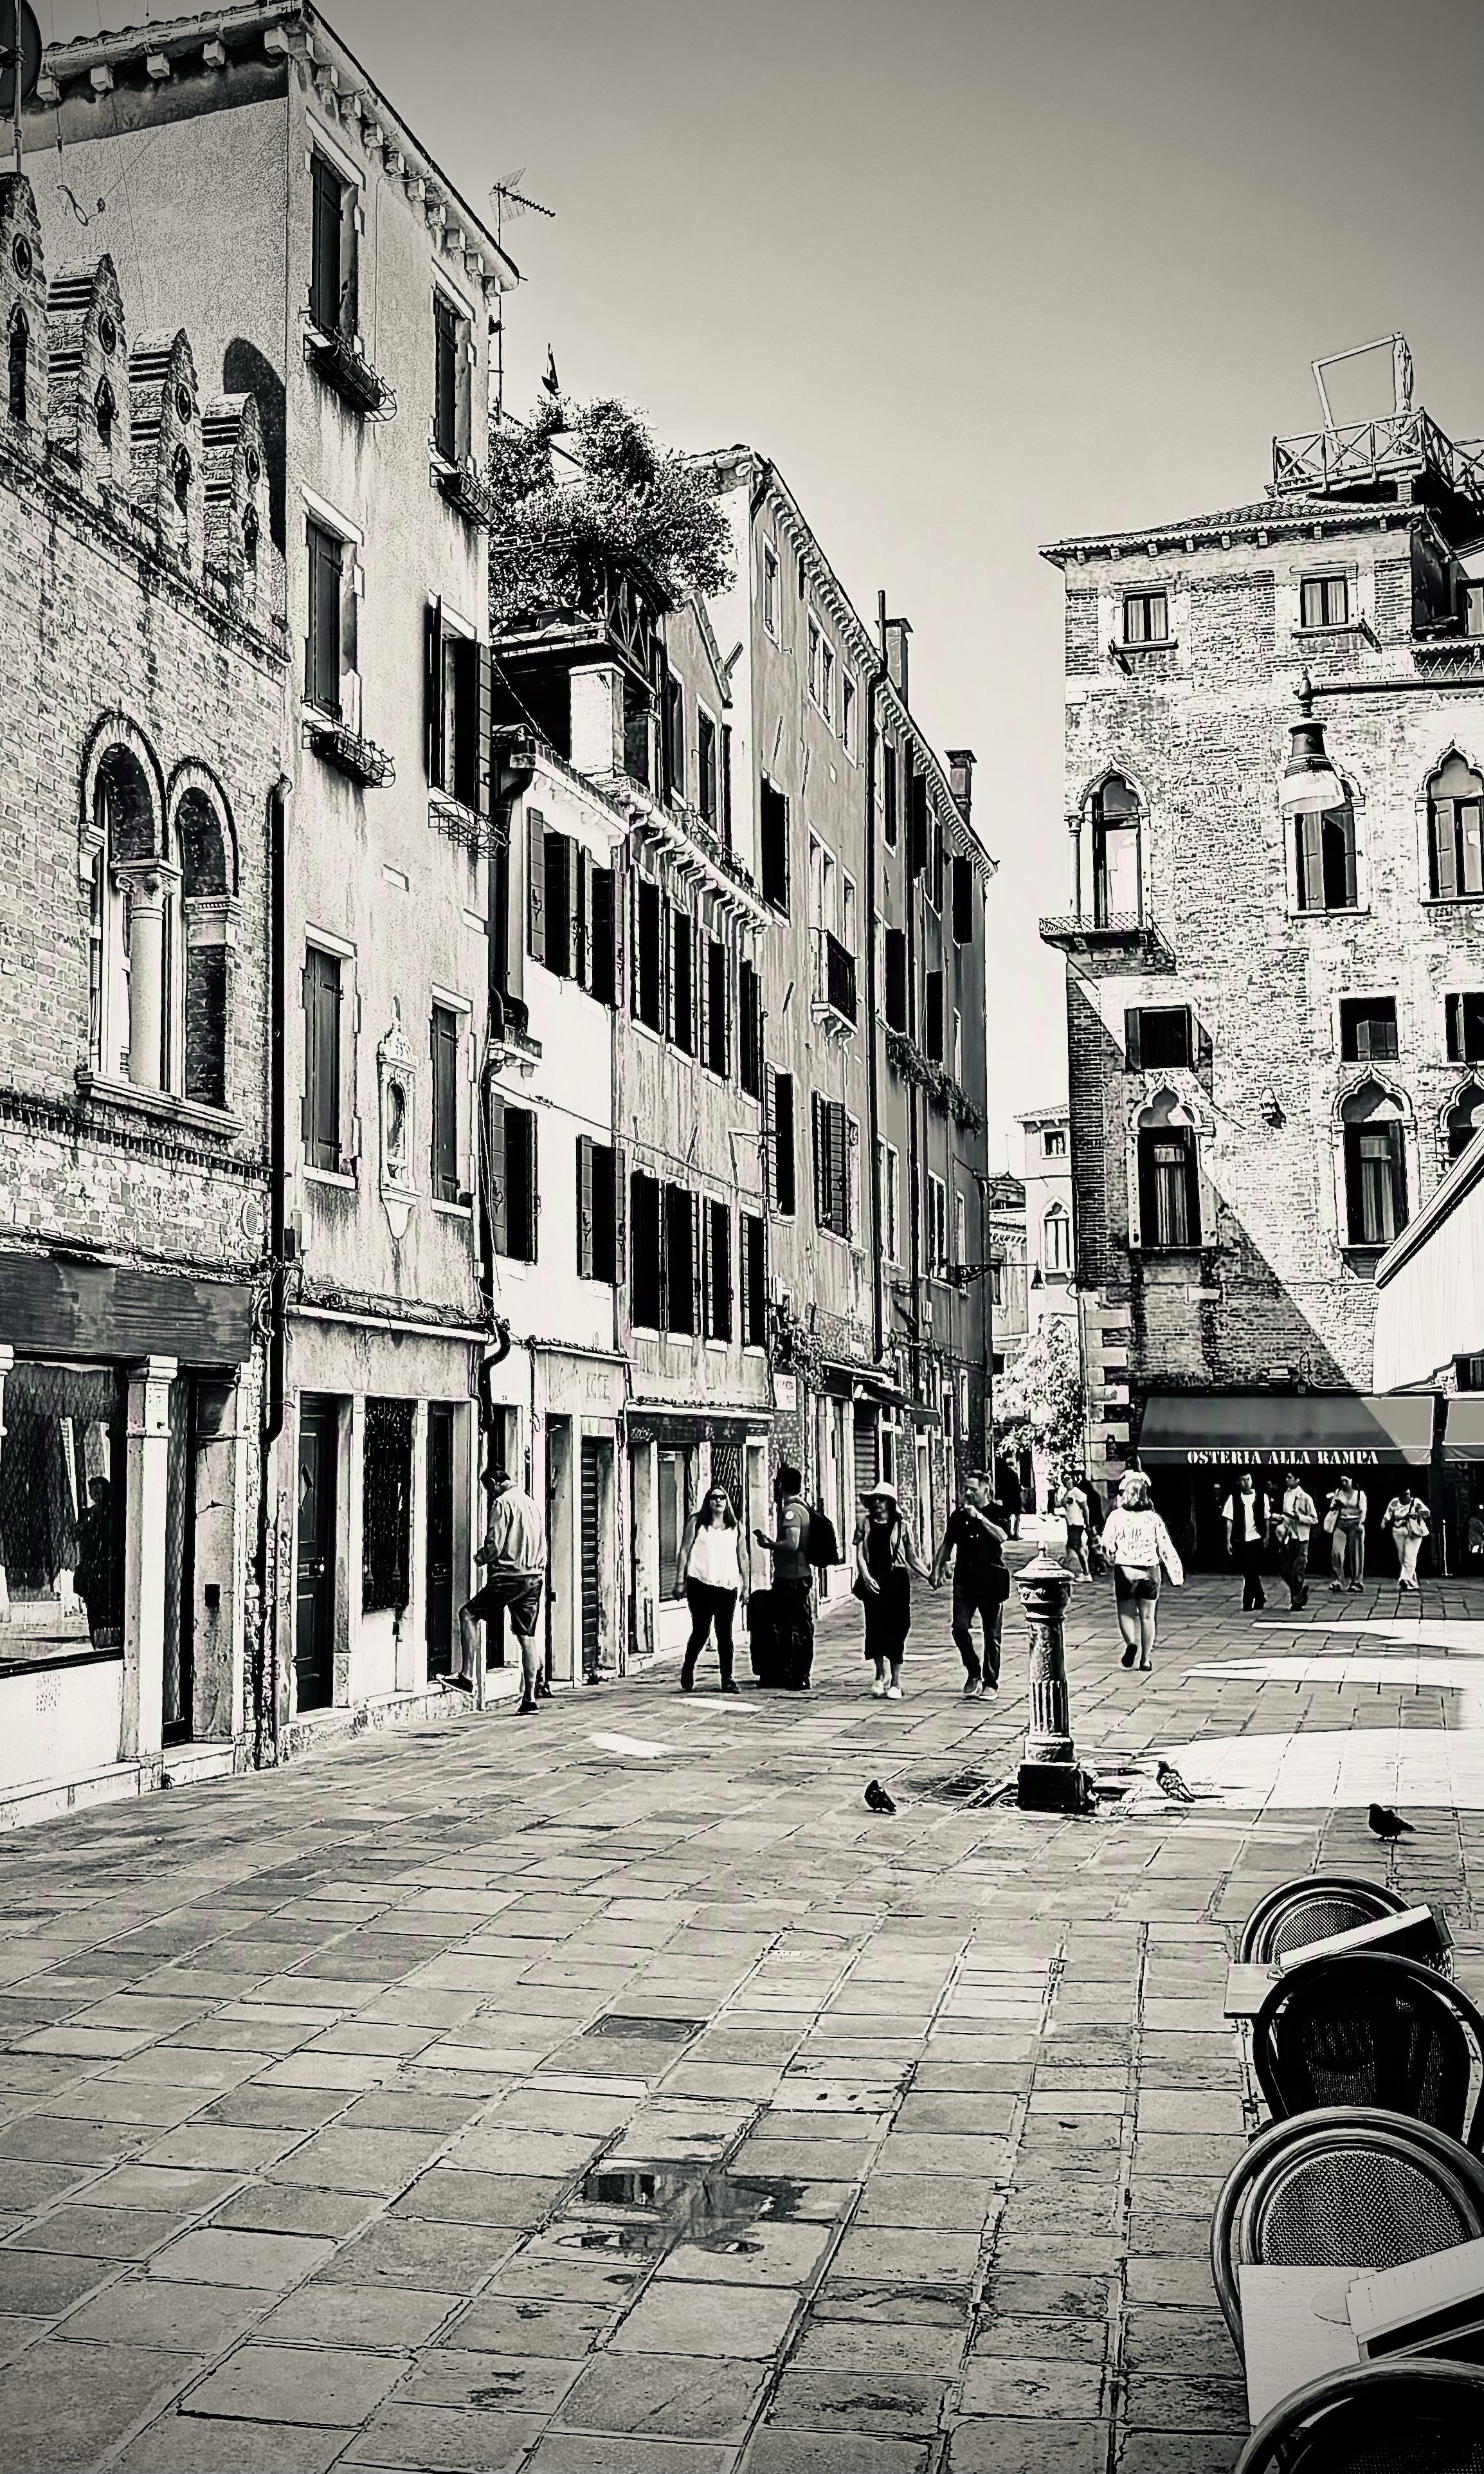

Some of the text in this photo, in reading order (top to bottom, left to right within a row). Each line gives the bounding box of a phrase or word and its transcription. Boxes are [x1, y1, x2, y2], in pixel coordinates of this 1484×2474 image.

[1187, 1451, 1379, 1464] OSTERIA ALLA RAMPA
